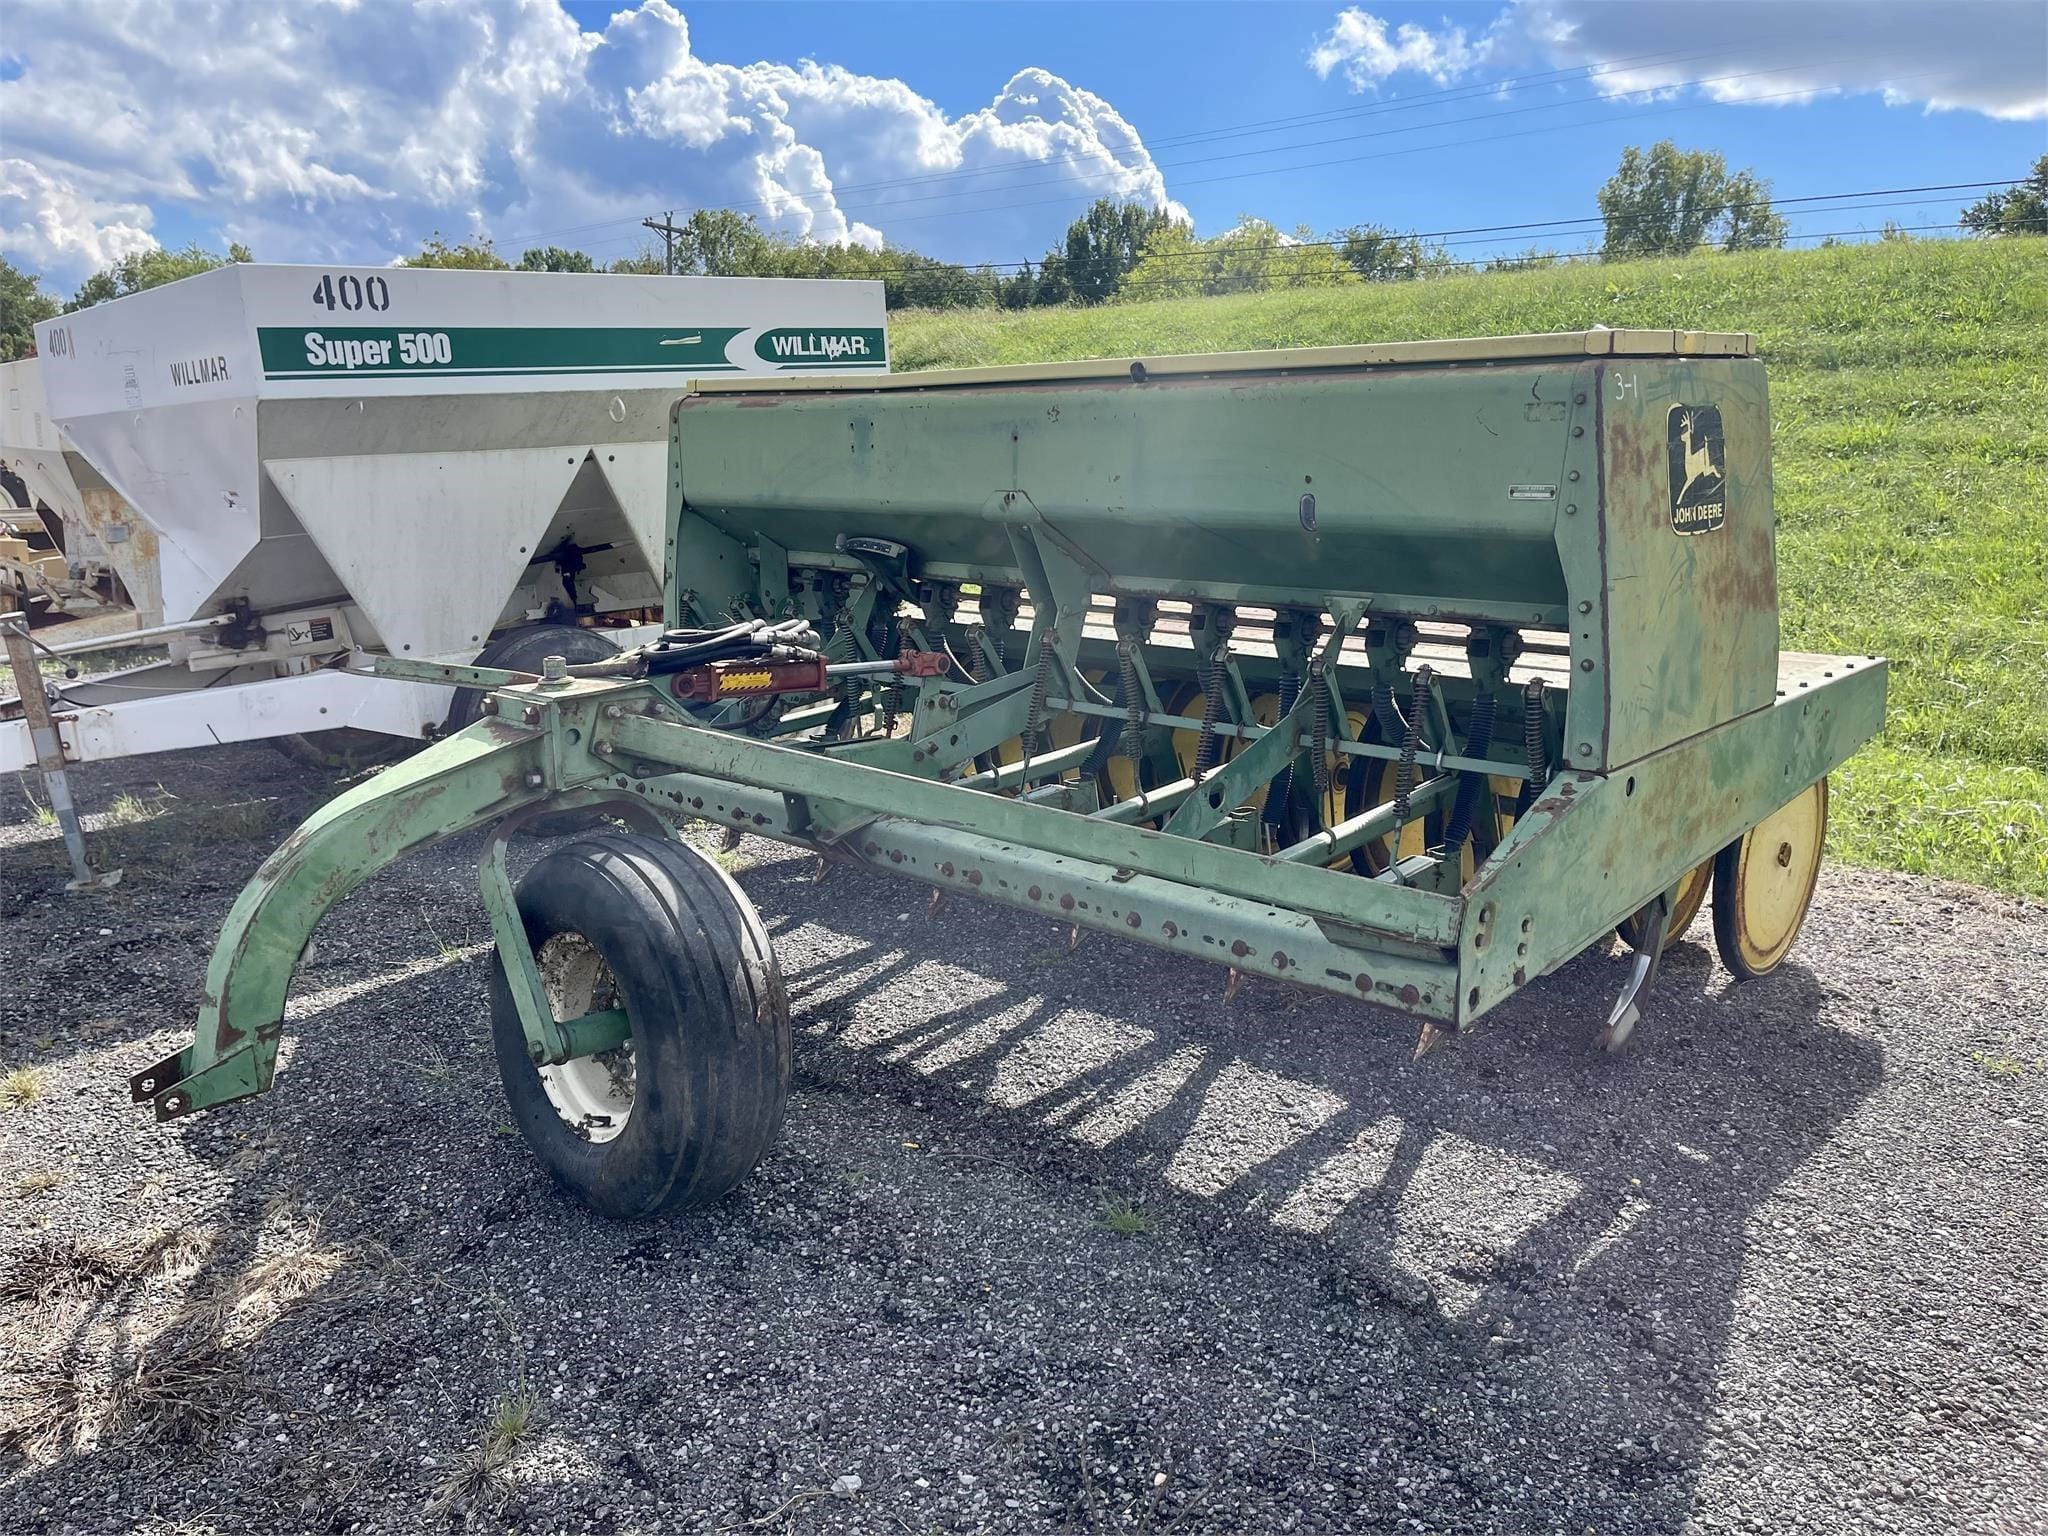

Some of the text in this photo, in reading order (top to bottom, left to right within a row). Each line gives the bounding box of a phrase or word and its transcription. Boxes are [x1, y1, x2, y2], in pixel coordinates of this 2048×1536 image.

[312, 274, 390, 311] 400
[49, 328, 67, 357] 400
[304, 332, 452, 369] Super 500
[771, 336, 866, 356] WILLMAR
[170, 356, 229, 387] WILLMAR
[1614, 373, 1638, 400] 3-1
[1674, 503, 1723, 524] JOHN DEERE
